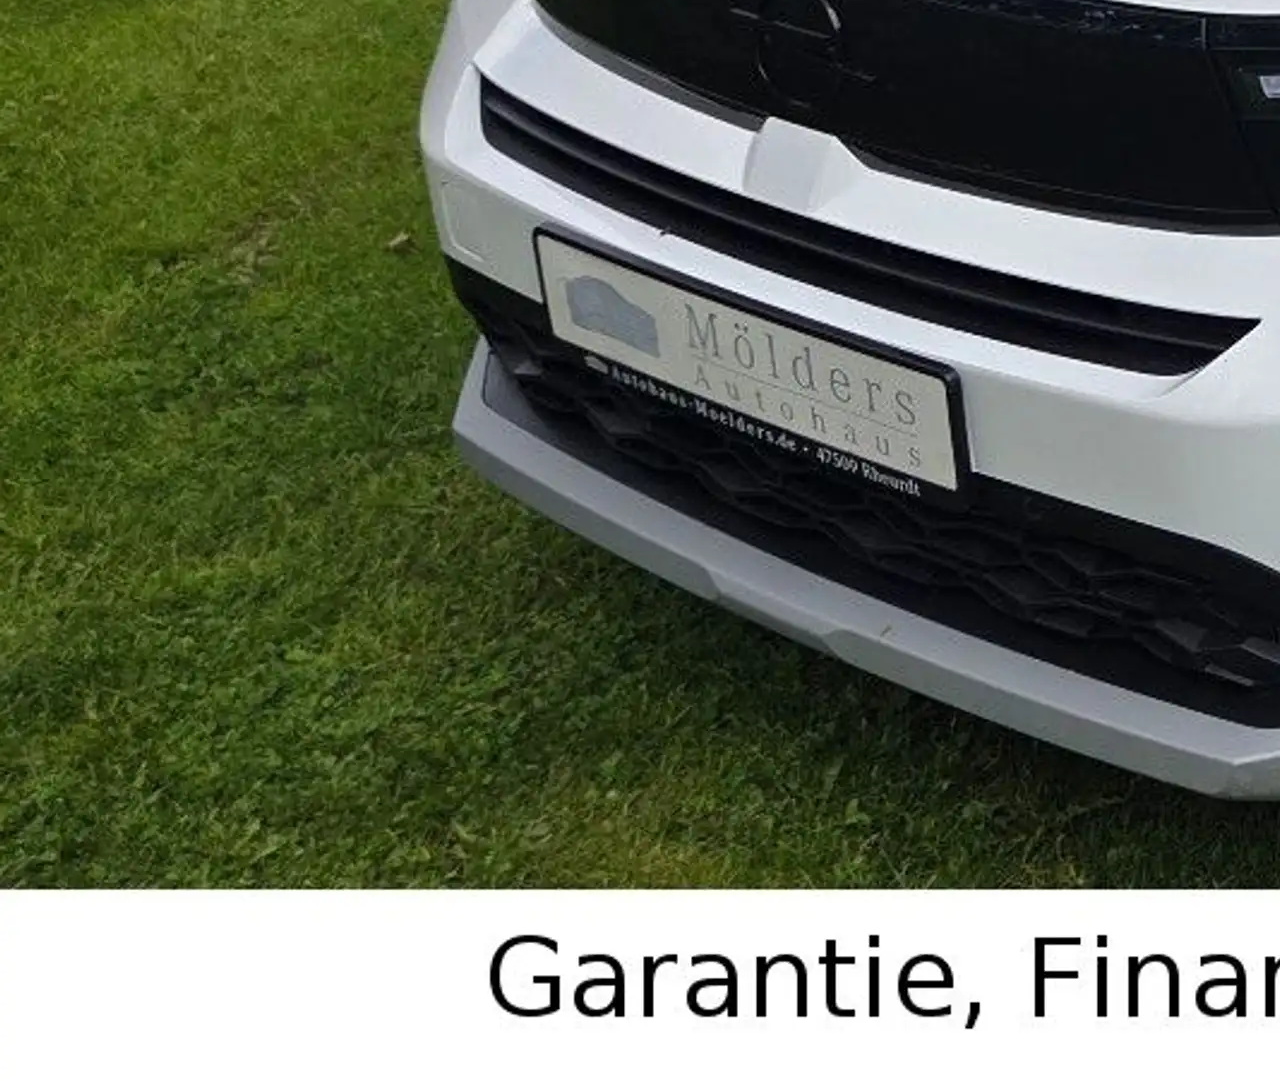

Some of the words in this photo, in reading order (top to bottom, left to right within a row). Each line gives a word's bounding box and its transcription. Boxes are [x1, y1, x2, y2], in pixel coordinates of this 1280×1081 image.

[611, 364, 797, 452] Autohaus-Moelders.de
[685, 303, 919, 427] Mölders
[694, 363, 922, 470] Autohaus
